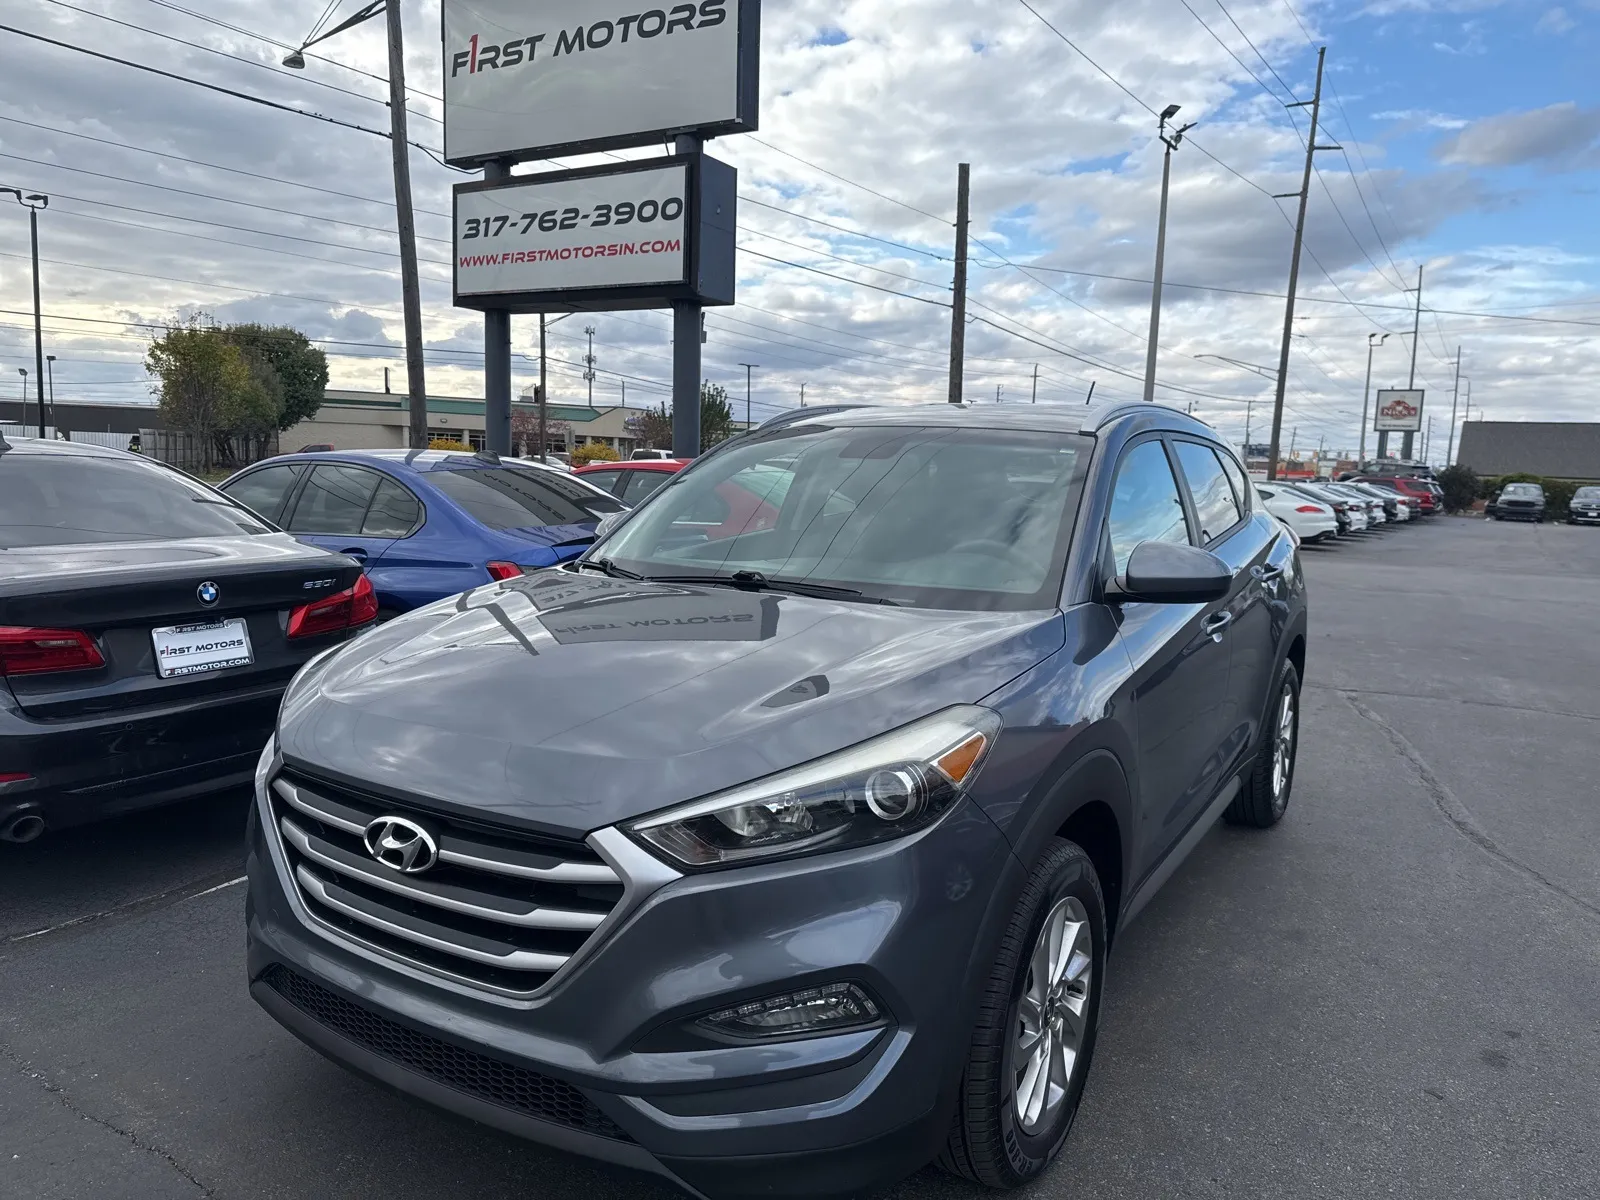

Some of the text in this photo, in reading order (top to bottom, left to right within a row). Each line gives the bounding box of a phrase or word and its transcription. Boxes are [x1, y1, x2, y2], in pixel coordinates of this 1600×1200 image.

[552, 0, 727, 57] MOTORS
[462, 197, 684, 240] 317-762-3900
[459, 239, 681, 268] WWW.FIRSTMOTORSIN.COM
[196, 622, 224, 630] MOTORS
[195, 638, 244, 652] MOTORS
